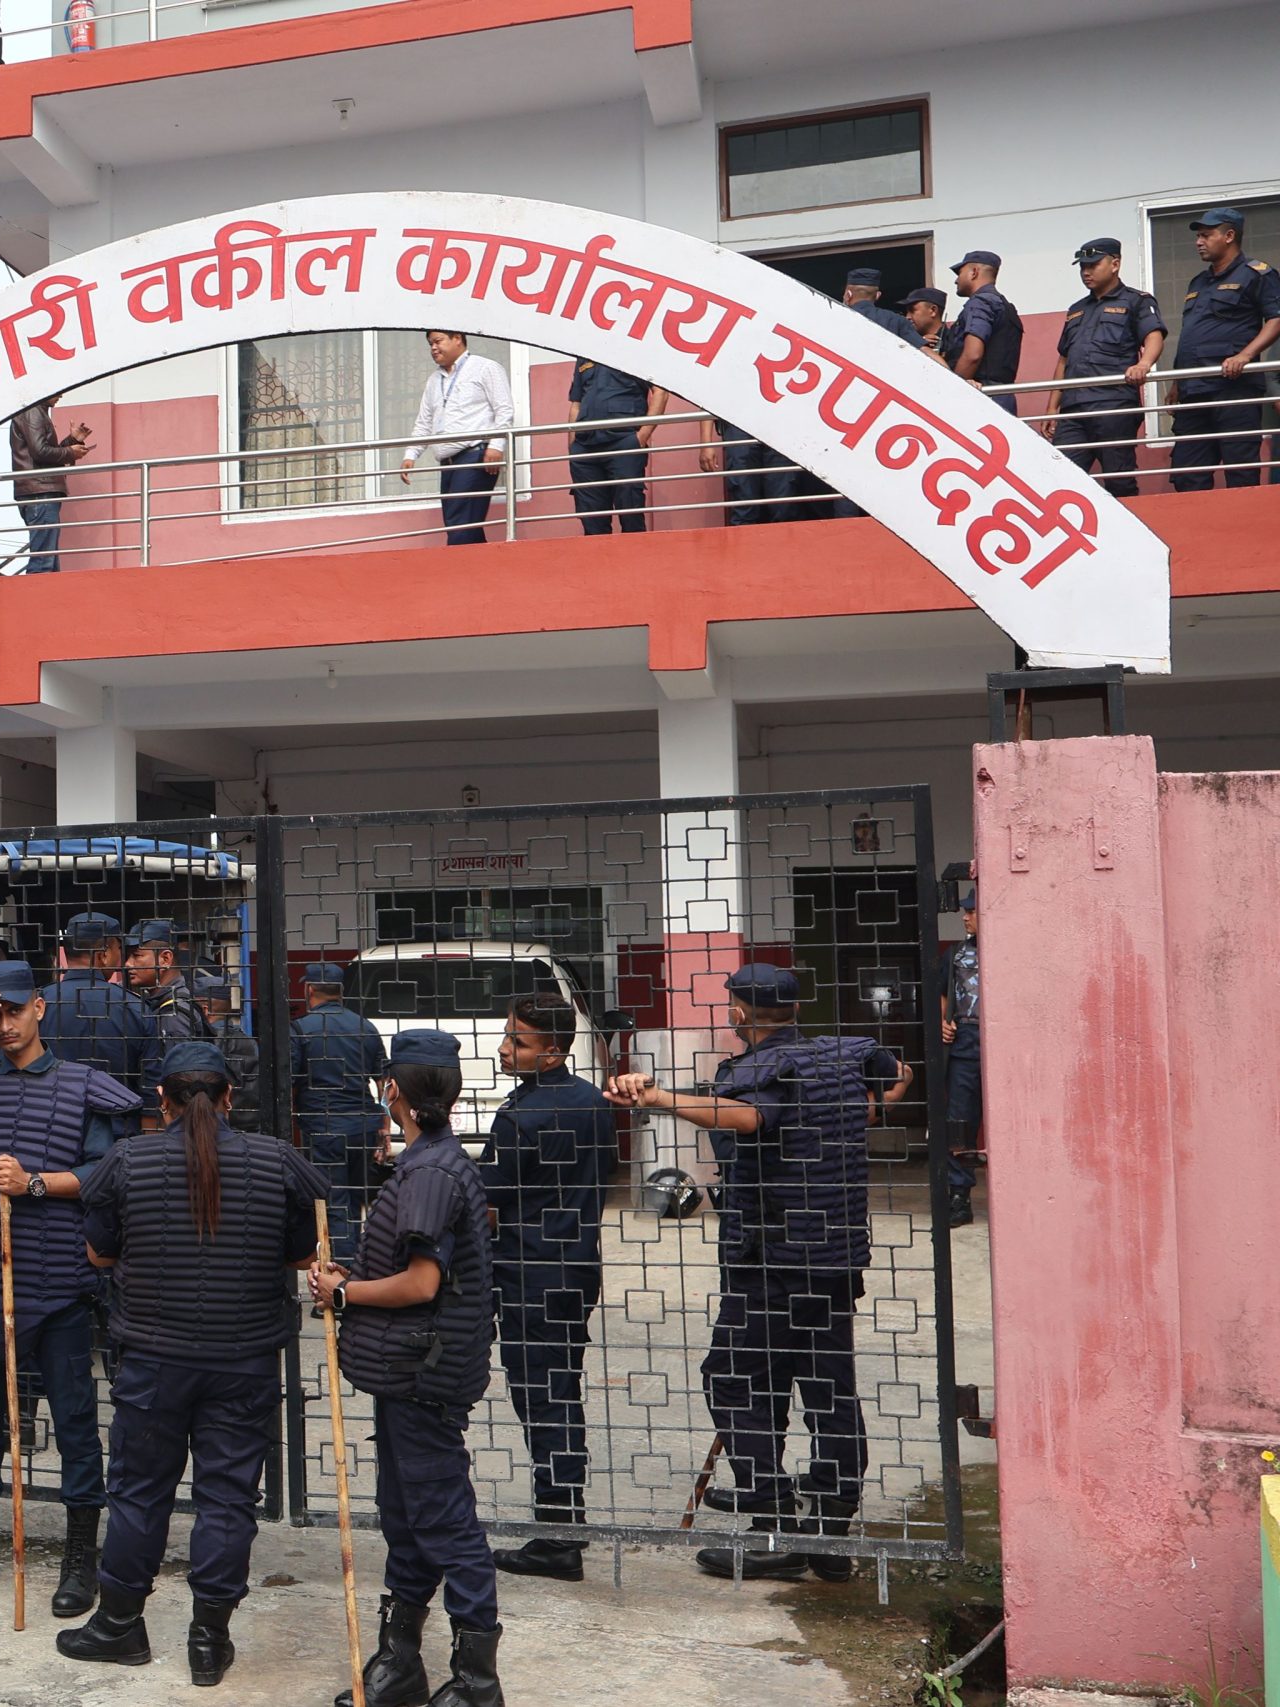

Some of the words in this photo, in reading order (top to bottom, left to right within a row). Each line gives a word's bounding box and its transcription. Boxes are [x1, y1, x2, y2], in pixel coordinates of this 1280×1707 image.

[121, 220, 377, 324] वकील
[395, 228, 756, 368] कार्यालय
[753, 323, 1099, 590] रुपन्देही
